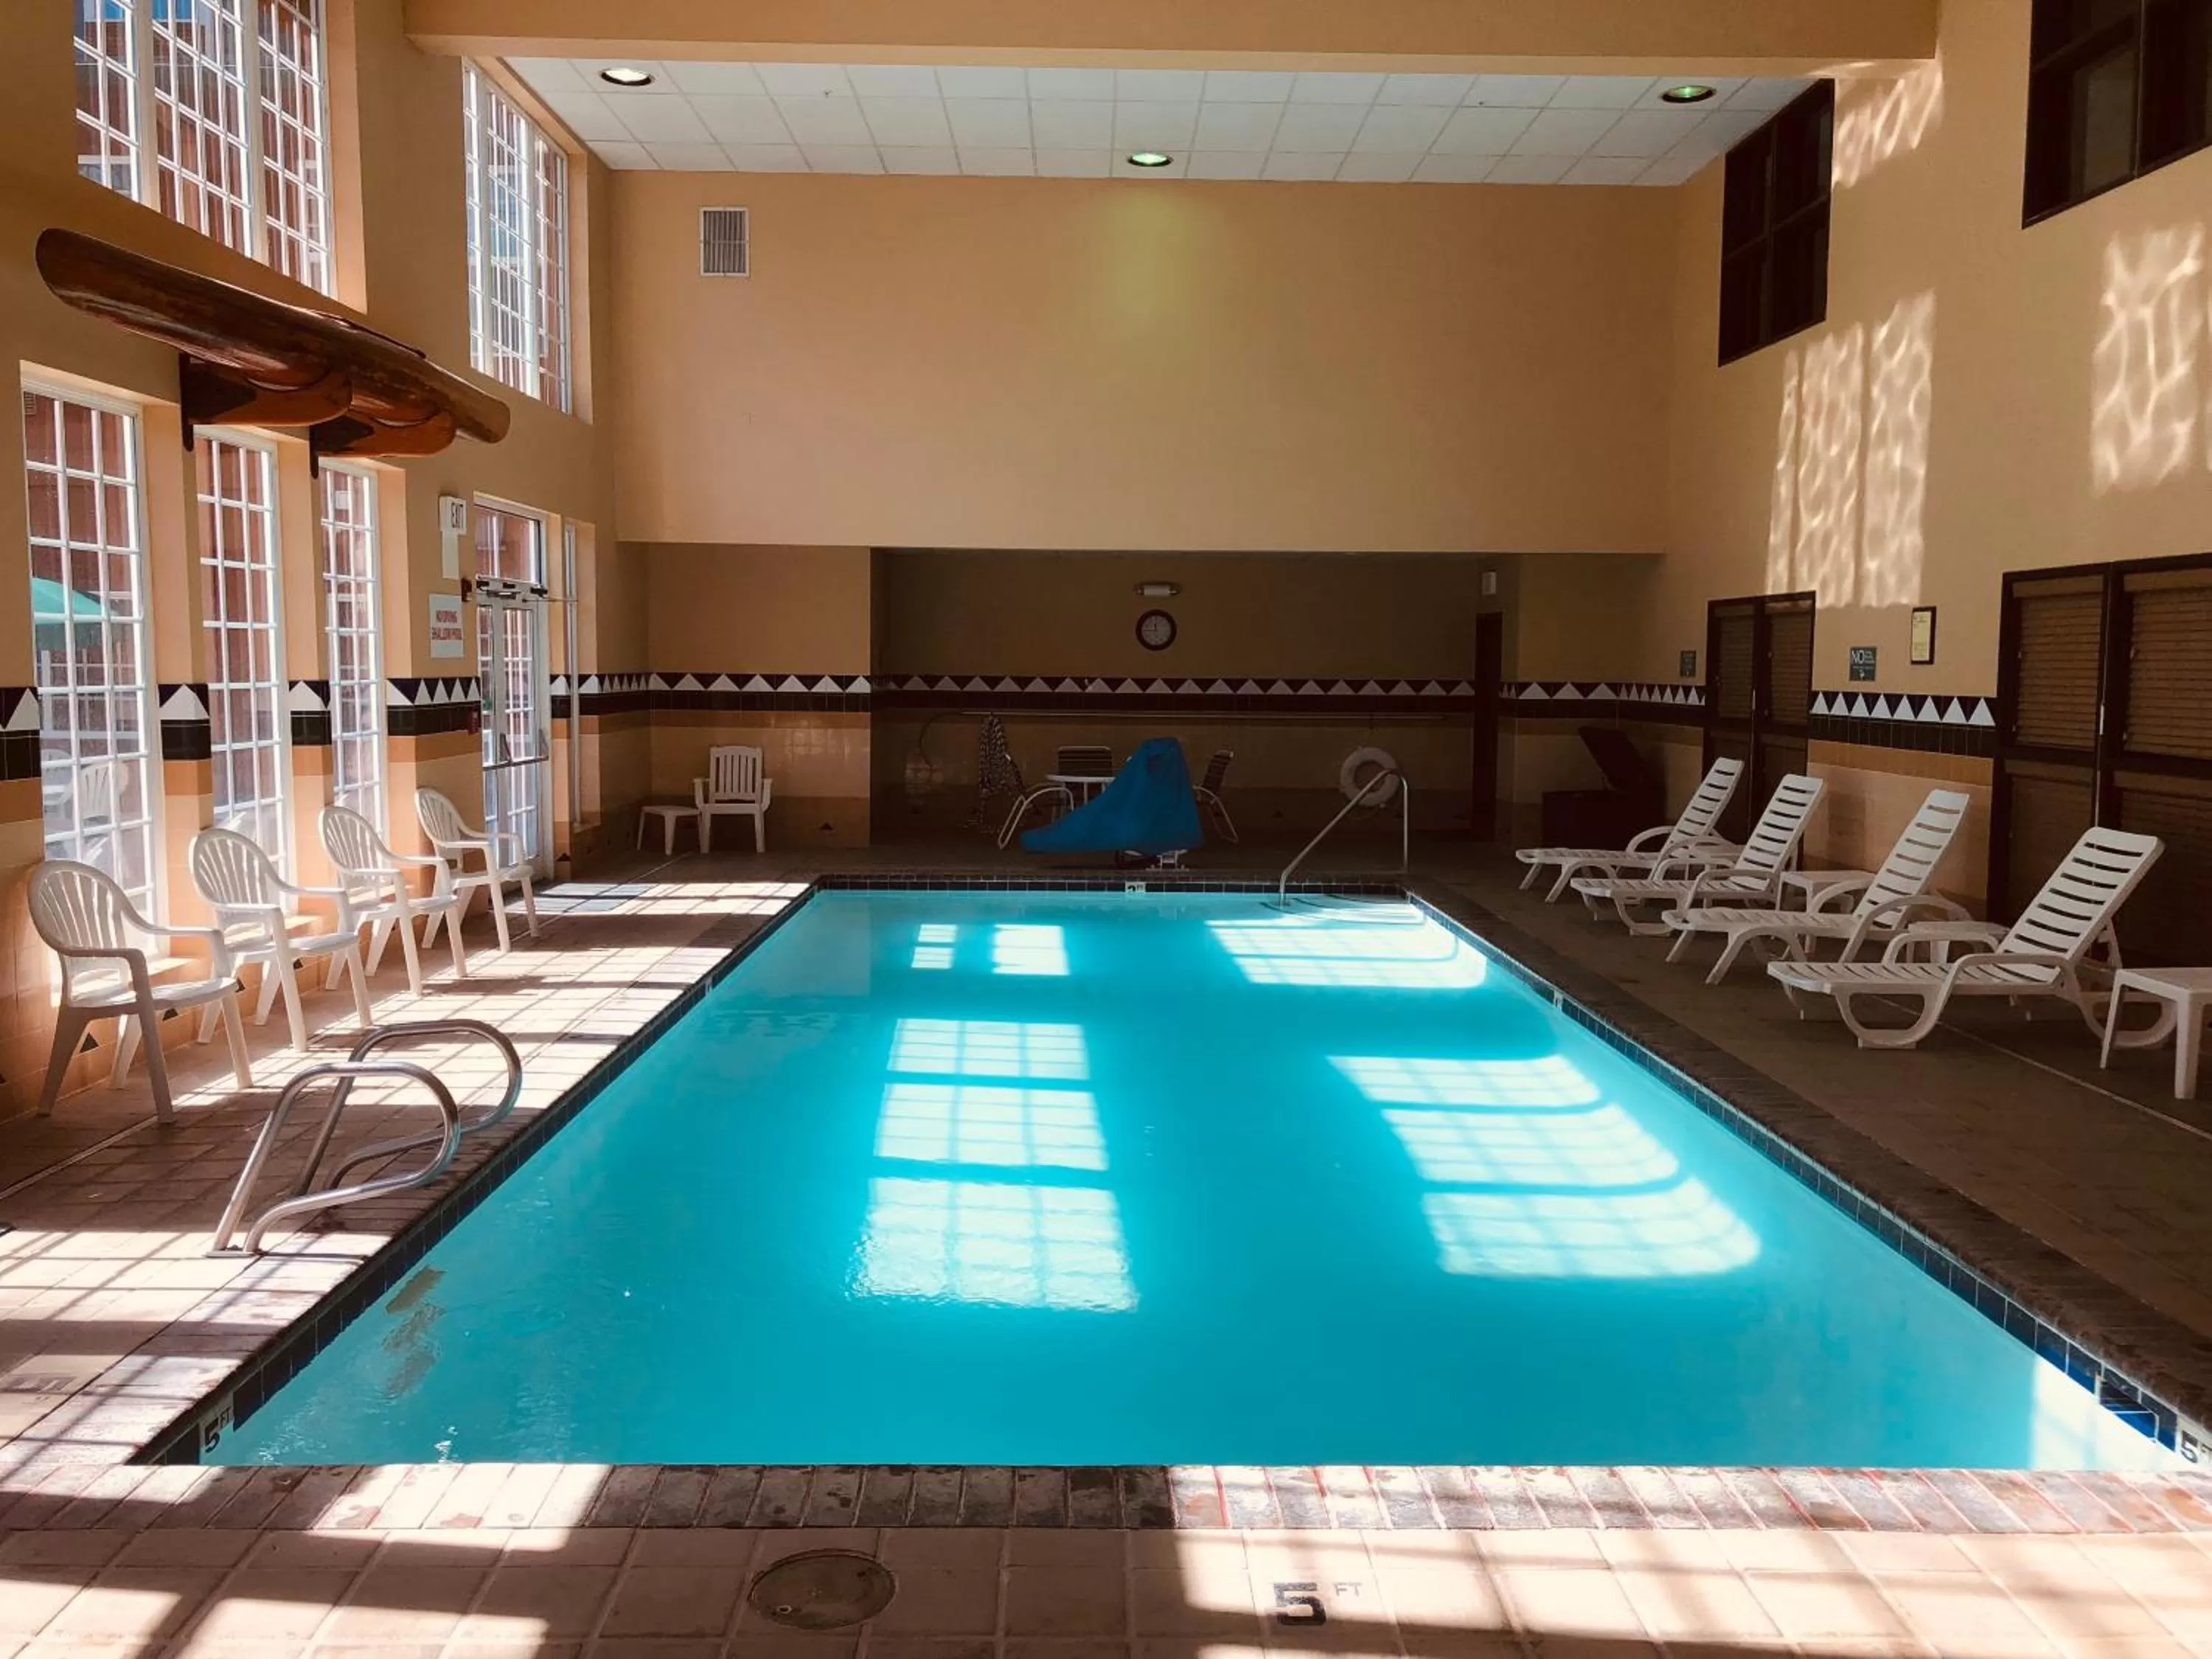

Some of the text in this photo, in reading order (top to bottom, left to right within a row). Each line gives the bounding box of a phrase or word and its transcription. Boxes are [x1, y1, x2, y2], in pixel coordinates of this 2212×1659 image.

[204, 1417, 220, 1453] 5
[2180, 1430, 2198, 1464] 5
[1273, 1582, 1362, 1626] 5 FT
